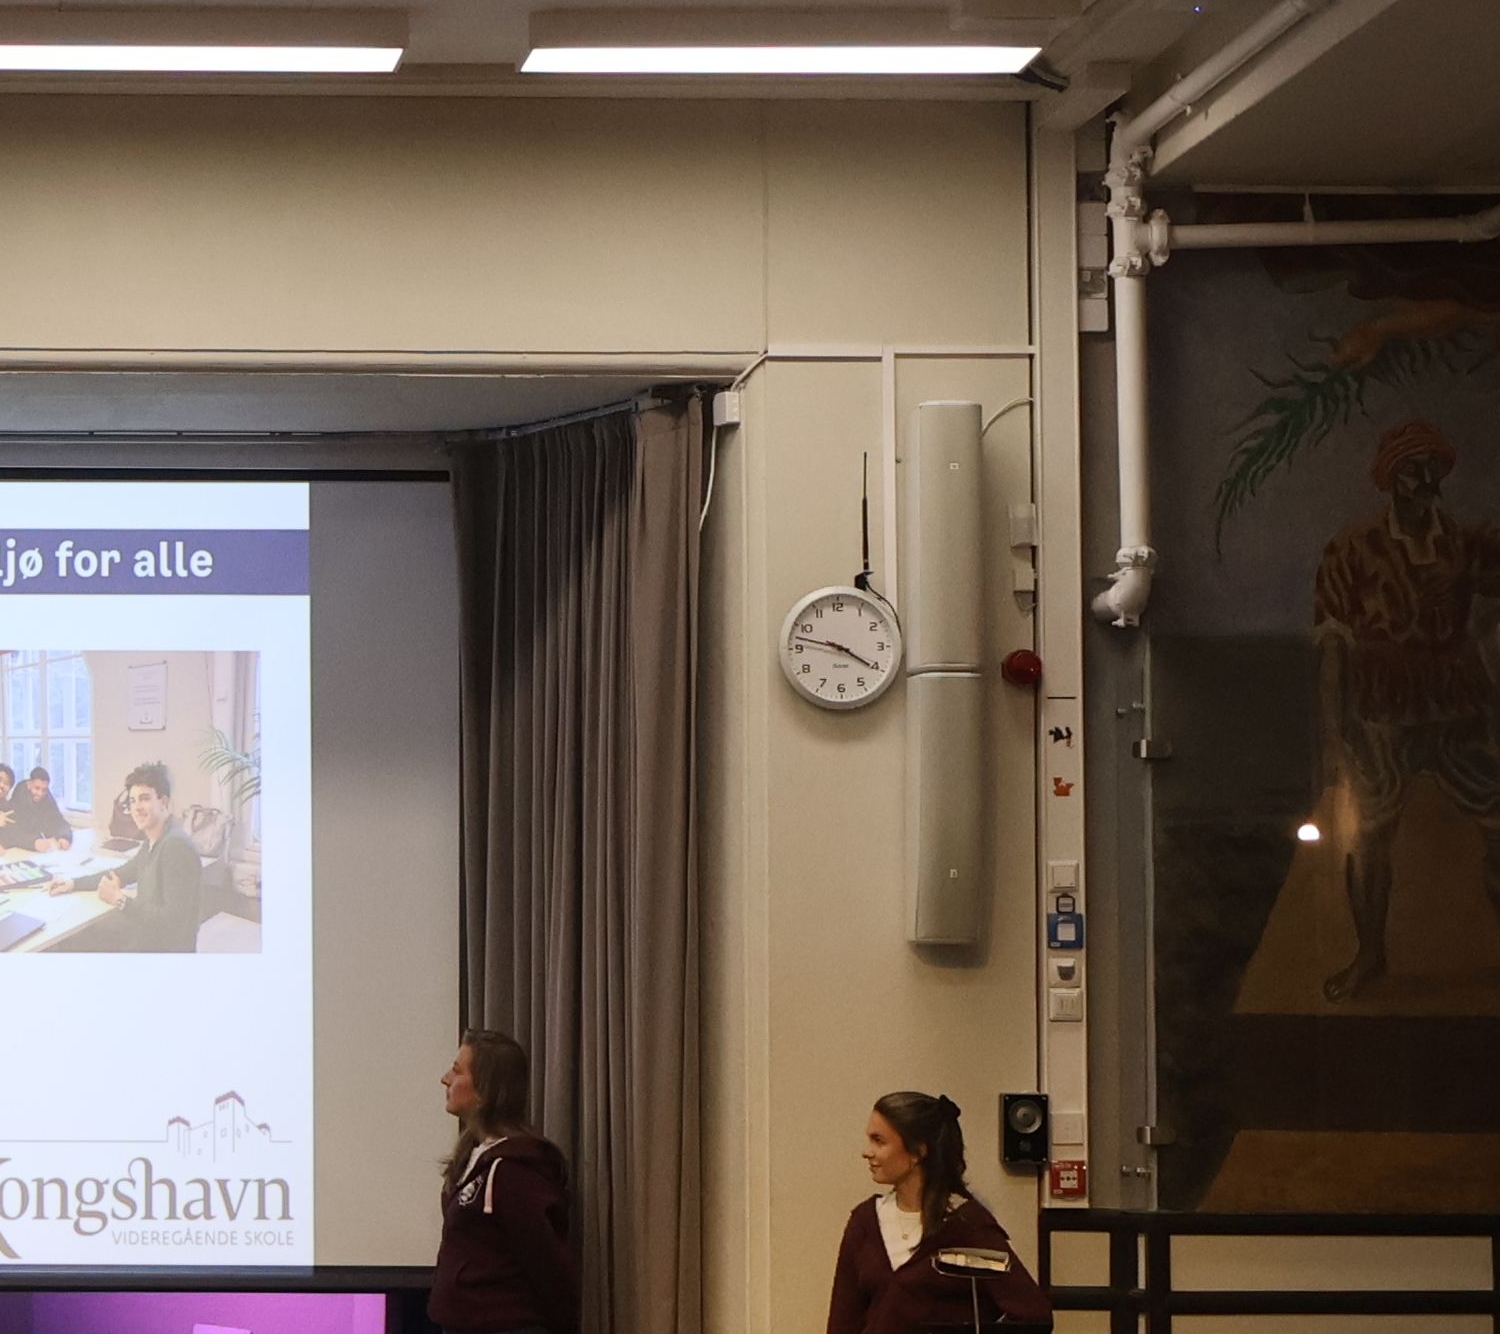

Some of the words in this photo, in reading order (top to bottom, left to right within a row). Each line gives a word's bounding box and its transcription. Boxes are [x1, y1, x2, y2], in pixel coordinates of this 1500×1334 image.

[54, 540, 121, 578] for
[133, 541, 213, 578] alle
[111, 1227, 238, 1246] VIDEREGÅENDE
[244, 1230, 294, 1246] SKOLE
